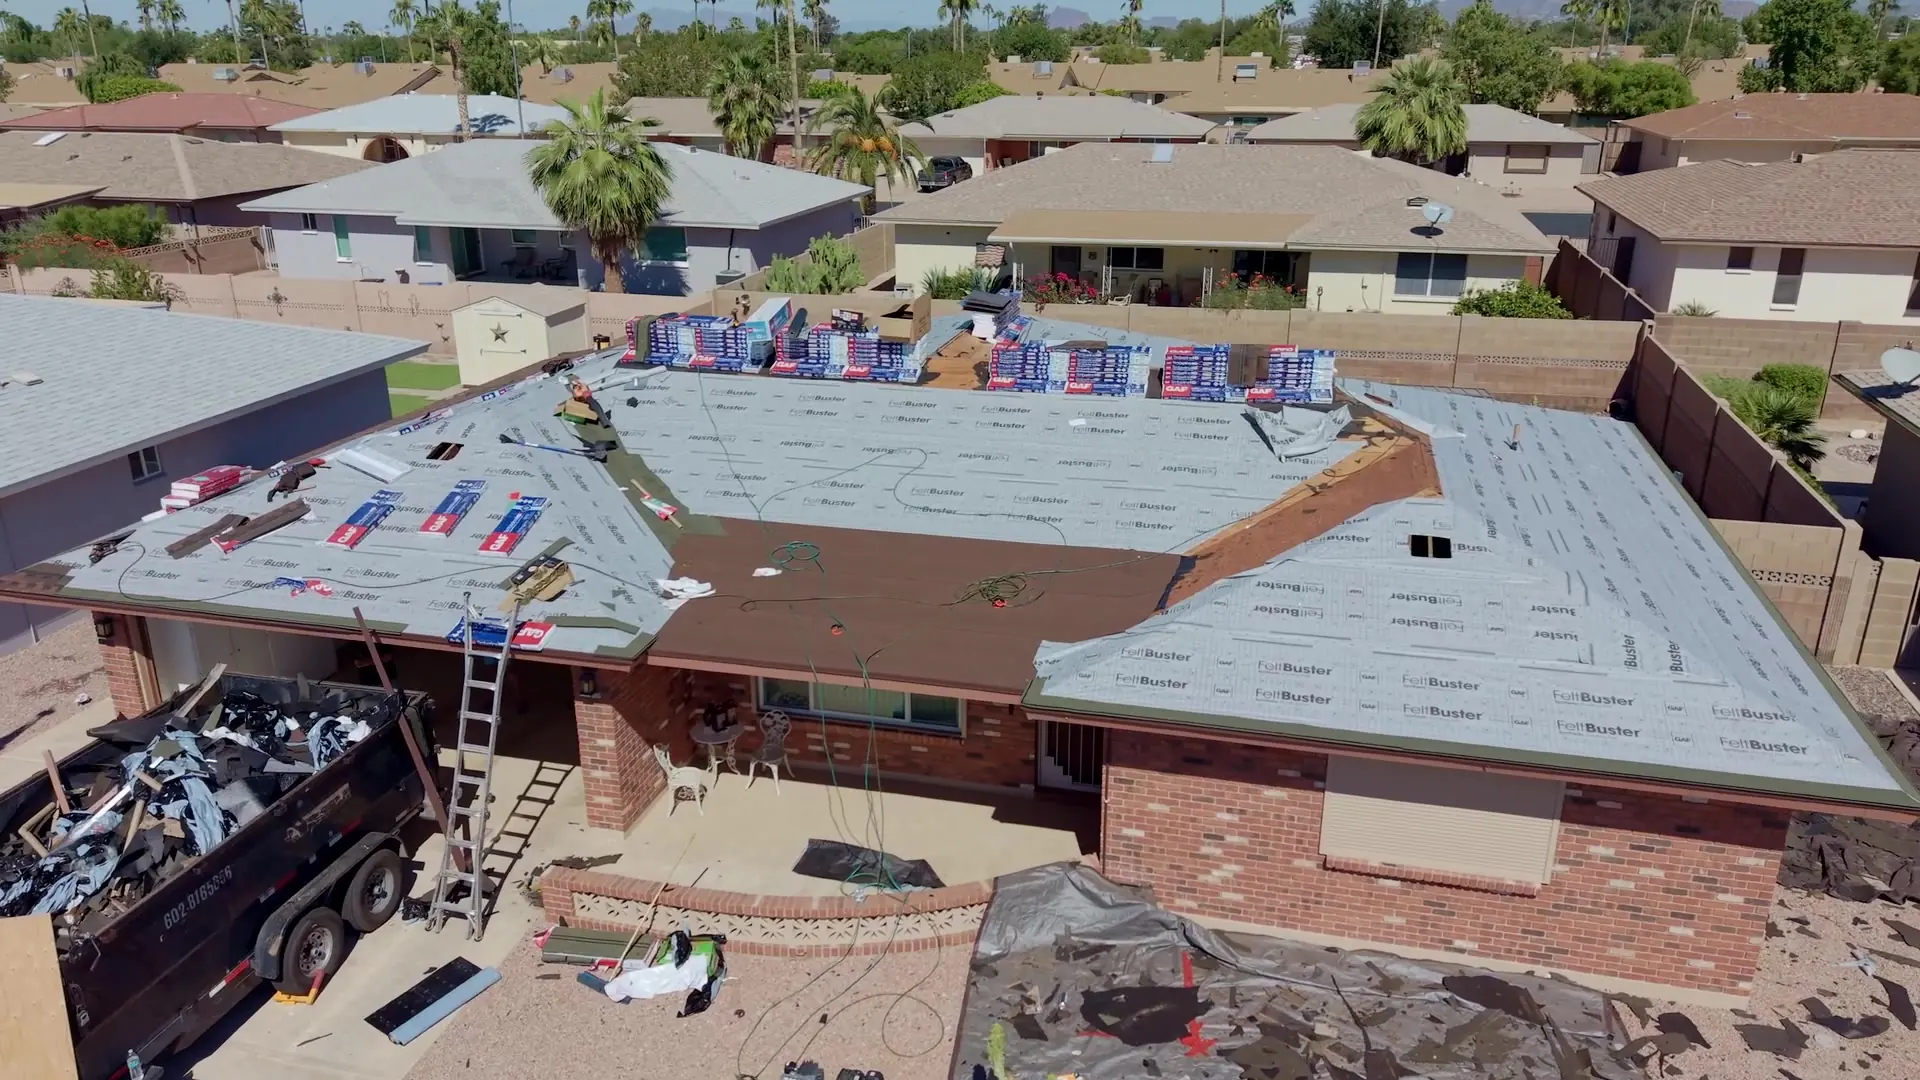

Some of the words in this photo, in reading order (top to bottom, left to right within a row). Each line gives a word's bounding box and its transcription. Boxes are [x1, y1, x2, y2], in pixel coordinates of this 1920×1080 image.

[489, 533, 509, 551] GAF
[517, 627, 544, 638] GAF
[1121, 648, 1192, 662] FeltBuster
[1258, 660, 1332, 676] FeltBuster
[1115, 672, 1188, 689] FeltBuster
[1402, 674, 1481, 691] FeltBuster
[1255, 688, 1332, 705] FeltBuster
[1553, 689, 1635, 706] FeltBuster
[1403, 703, 1483, 720] FeltBuster
[1557, 719, 1641, 738] FeltBuster
[1720, 736, 1808, 755] FeltBuster
